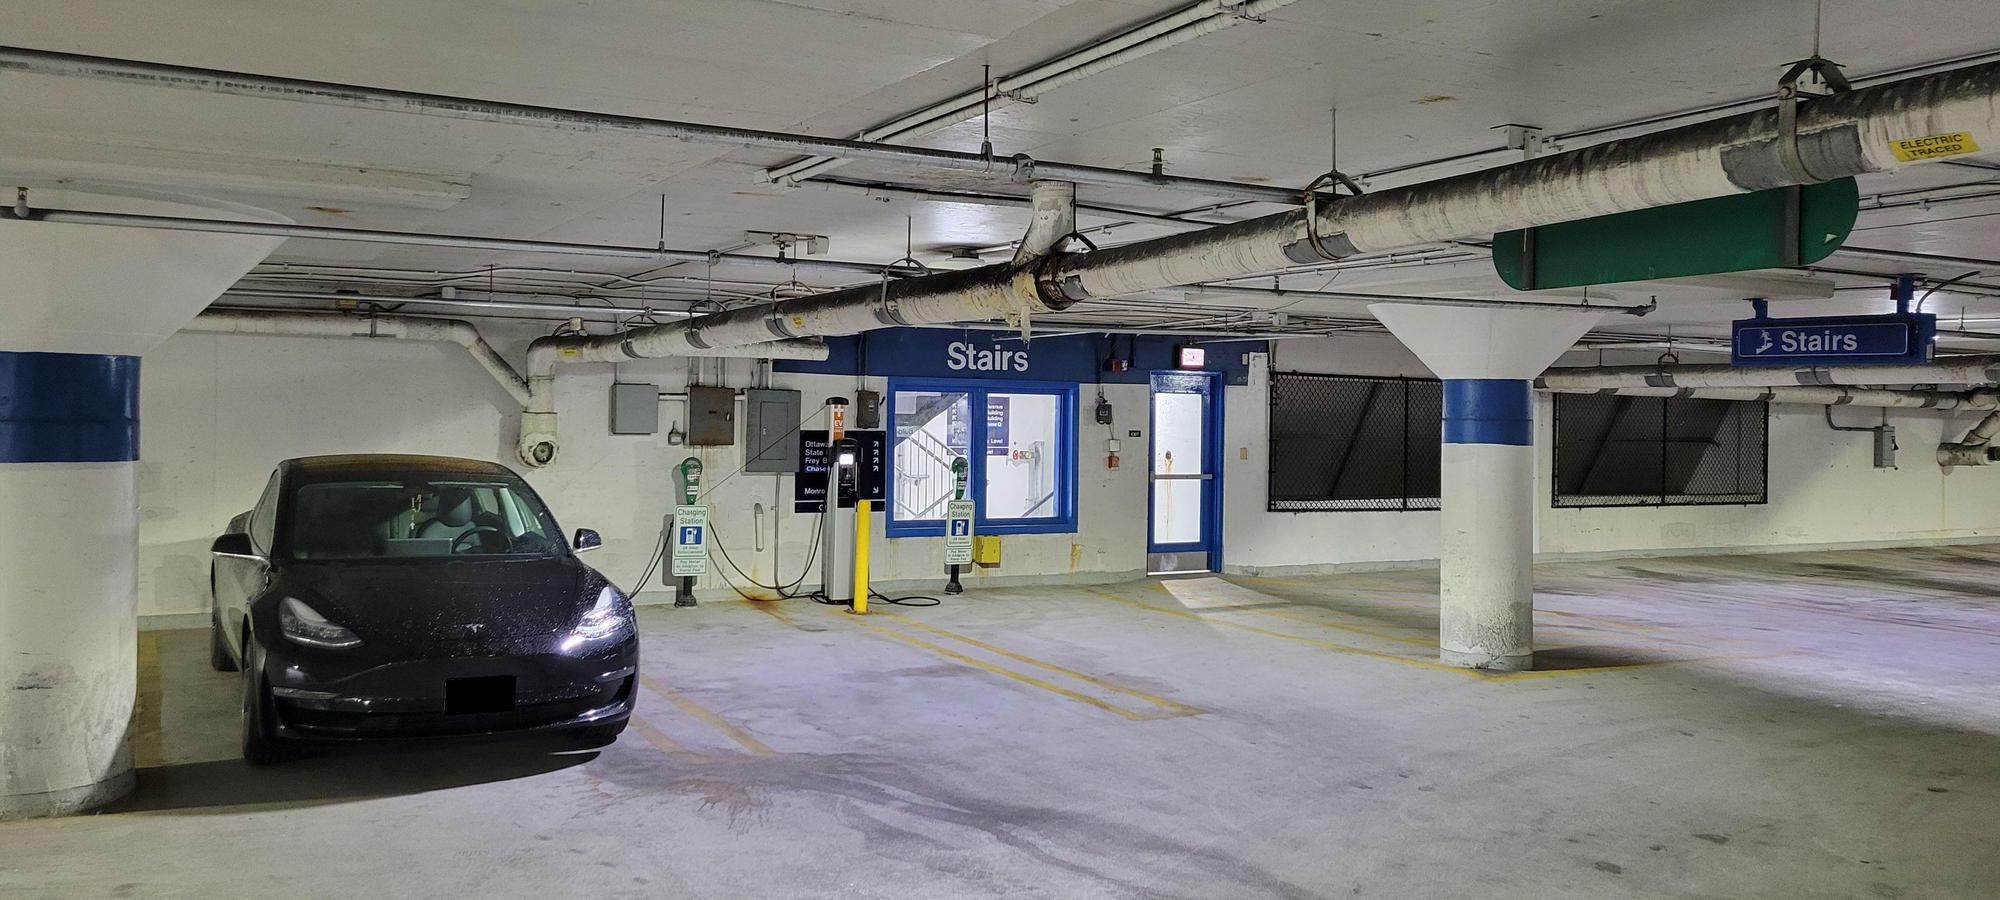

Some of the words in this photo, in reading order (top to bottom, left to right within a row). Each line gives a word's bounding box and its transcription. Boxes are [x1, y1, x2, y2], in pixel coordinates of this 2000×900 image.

[1900, 134, 1963, 150] ELECTRIC
[1908, 144, 1963, 157] TRACED
[1781, 330, 1858, 352] Stairs
[947, 341, 1029, 372] Stairs
[805, 448, 824, 456] State
[805, 457, 820, 465] Frey
[804, 487, 826, 495] Monro
[950, 502, 973, 511] Charging
[677, 508, 706, 517] Charging
[680, 517, 704, 525] Station
